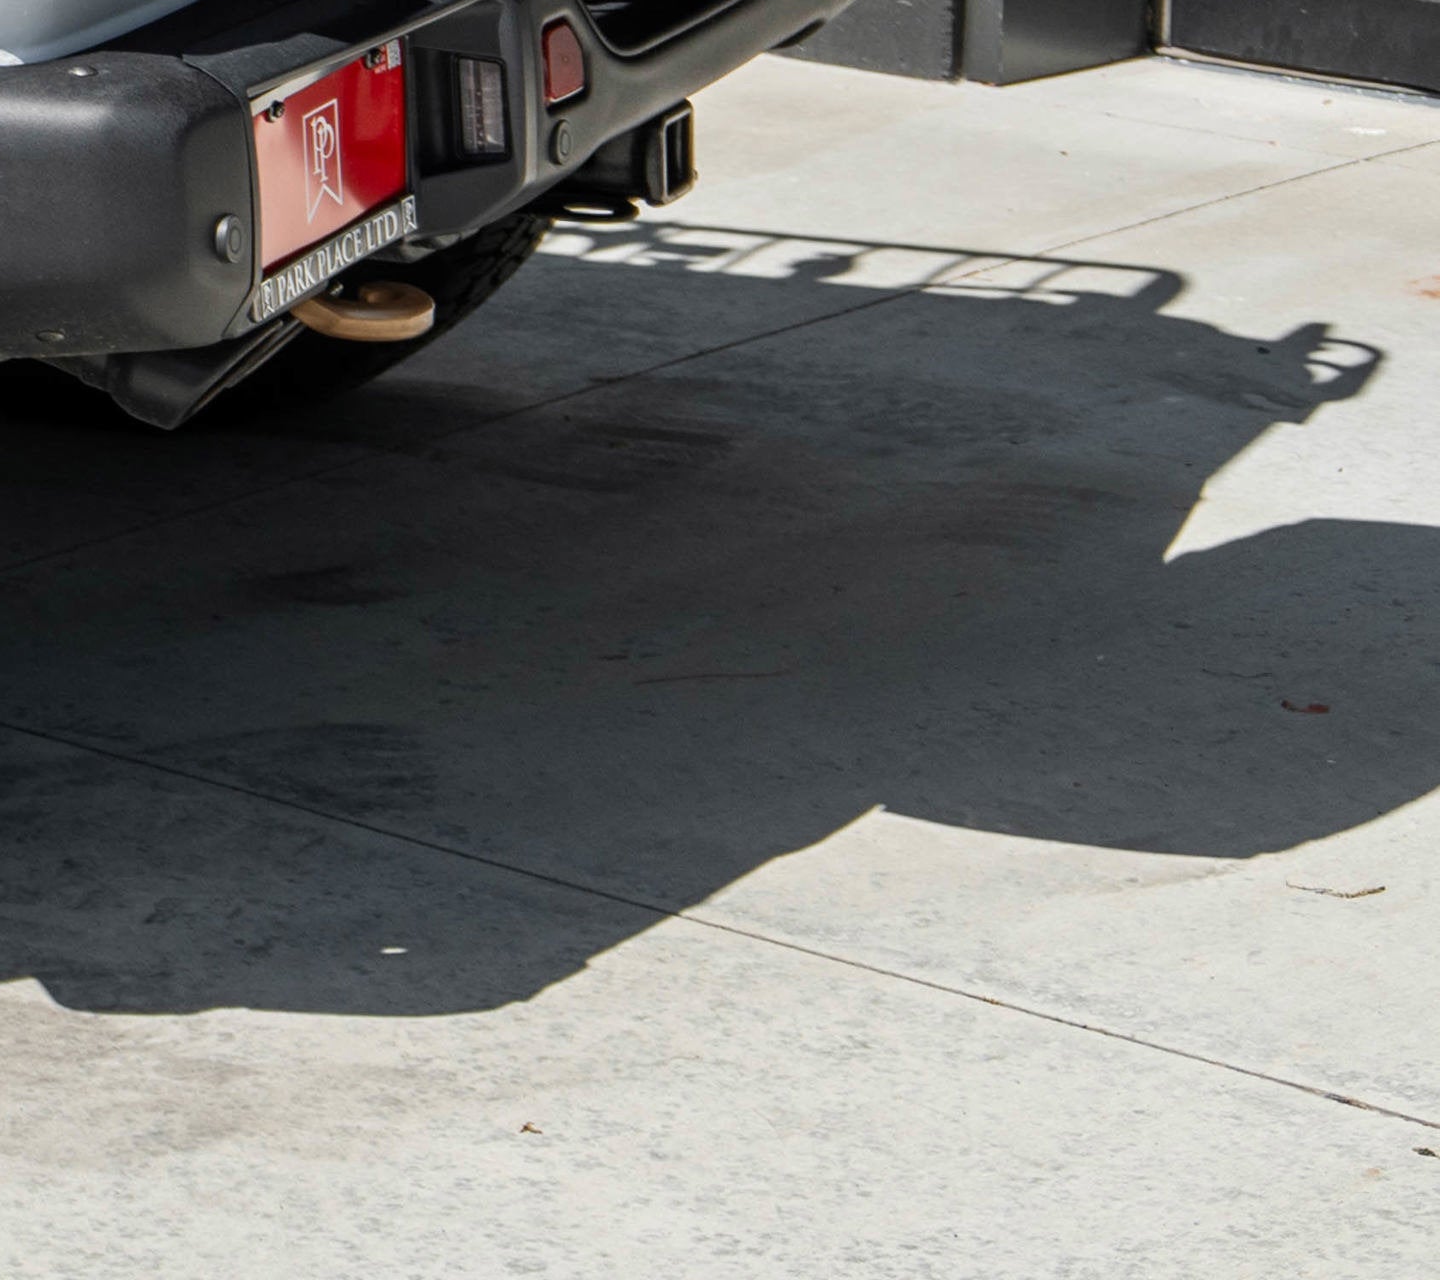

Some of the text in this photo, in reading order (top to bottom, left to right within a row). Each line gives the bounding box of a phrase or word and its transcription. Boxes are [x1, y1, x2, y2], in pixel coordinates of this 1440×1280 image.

[276, 258, 316, 308] PARK
[316, 230, 363, 287] PLACE
[364, 209, 400, 252] LTD
